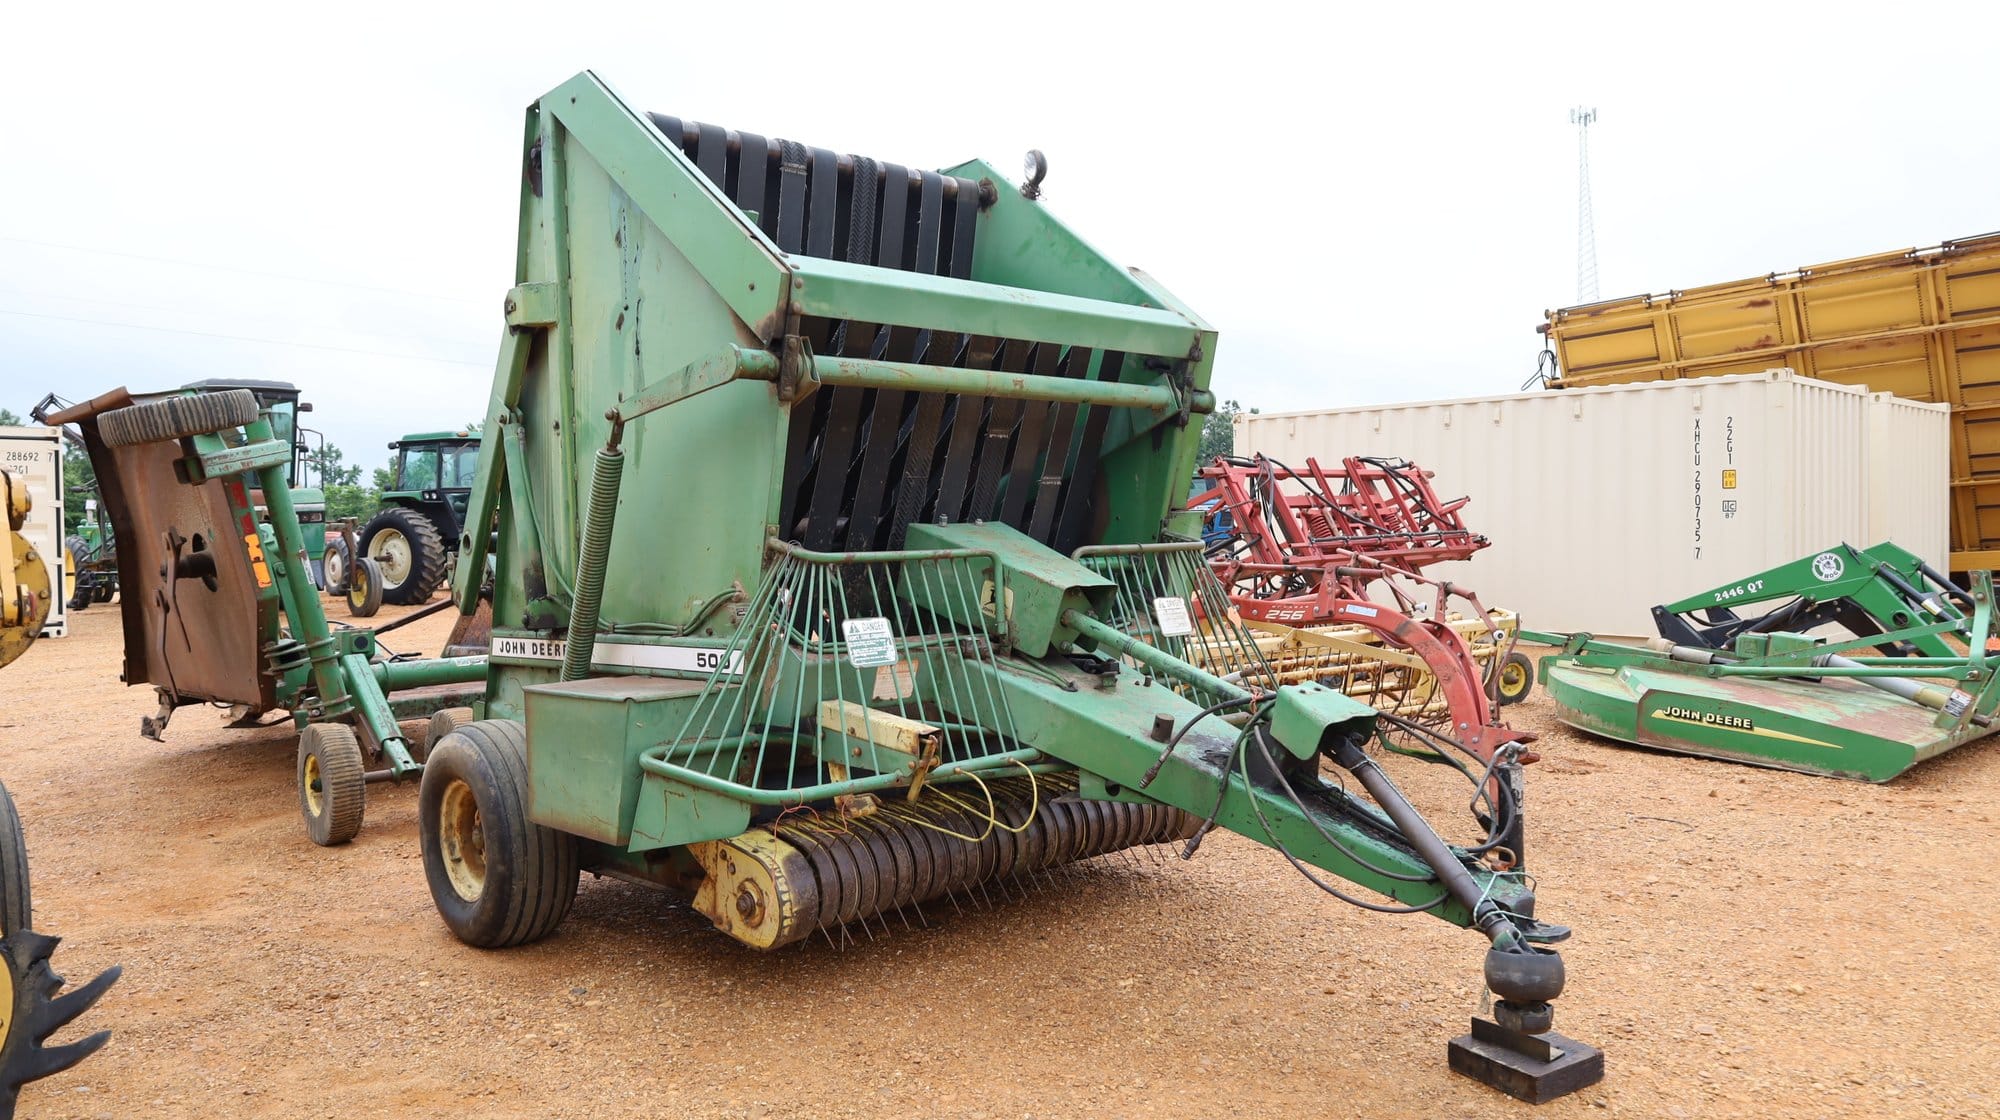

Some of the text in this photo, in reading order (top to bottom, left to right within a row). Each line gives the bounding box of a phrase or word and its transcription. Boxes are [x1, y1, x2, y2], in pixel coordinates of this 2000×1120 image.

[6, 451, 53, 462] 288692 7
[1695, 547, 1701, 560] 7
[1714, 580, 1764, 602] 2446 QT
[1265, 609, 1305, 619] 256
[499, 640, 526, 655] JOHN
[1663, 706, 1752, 729] JOHN DEERE
